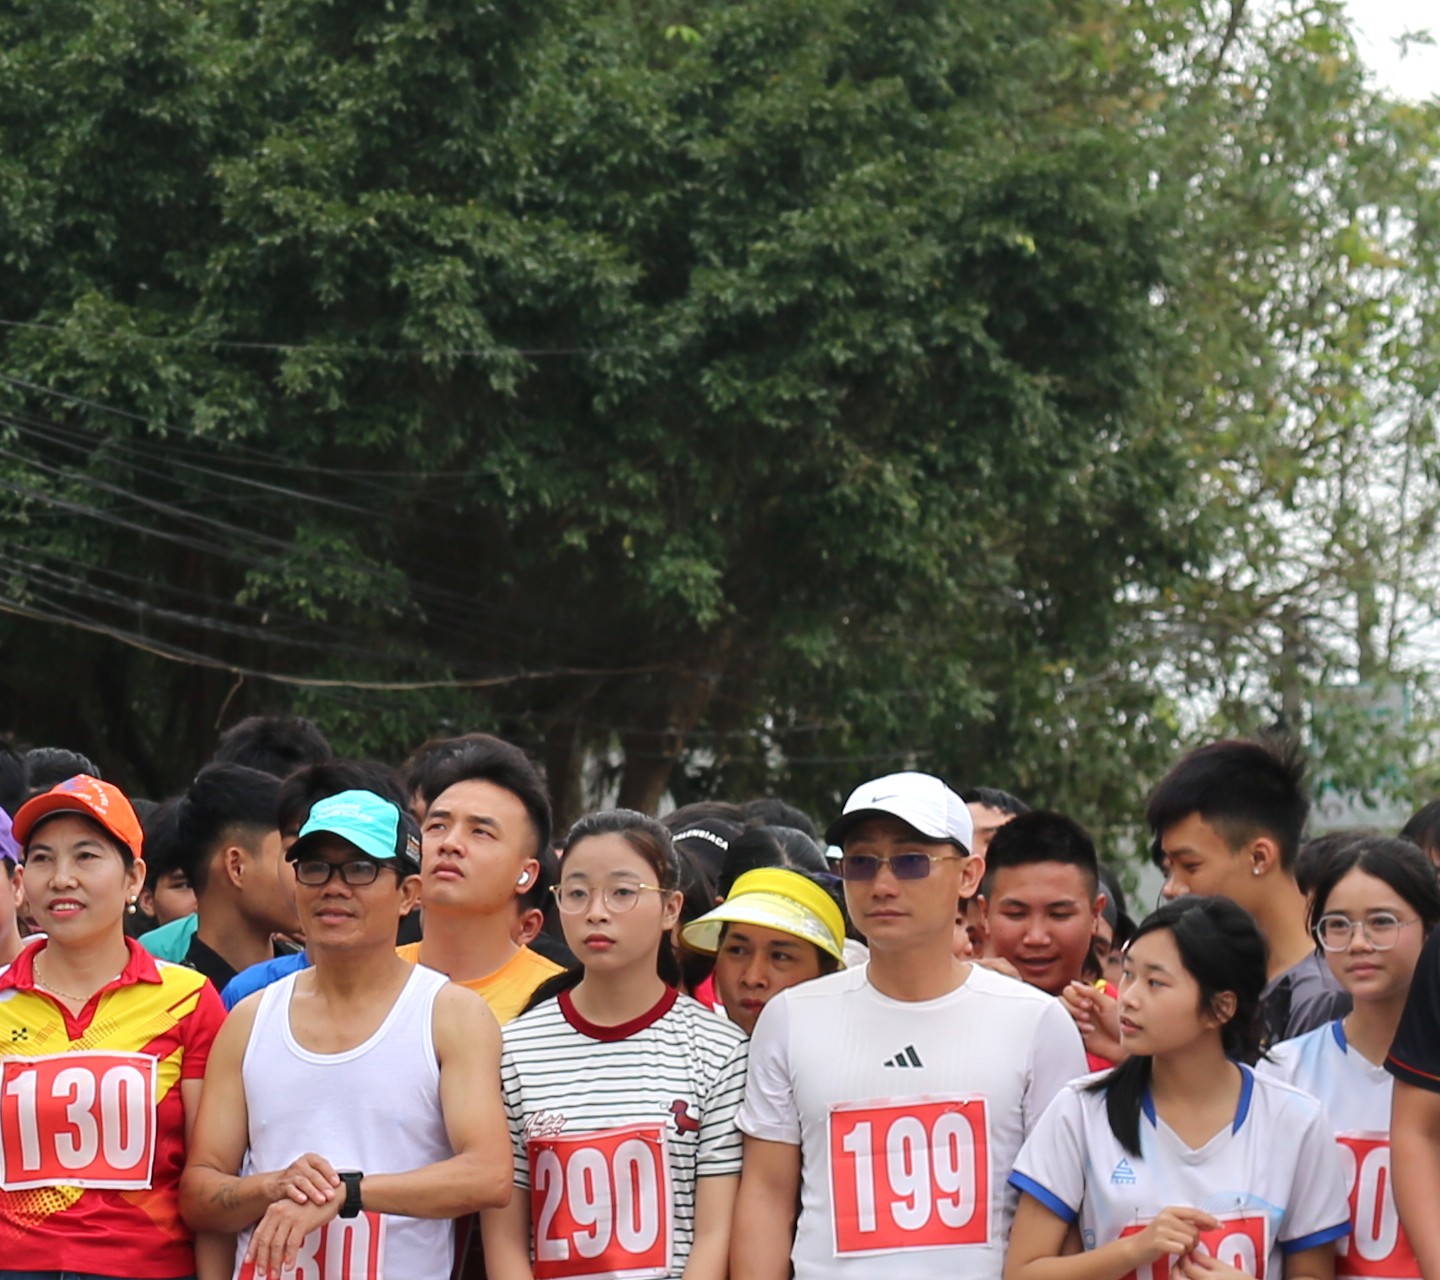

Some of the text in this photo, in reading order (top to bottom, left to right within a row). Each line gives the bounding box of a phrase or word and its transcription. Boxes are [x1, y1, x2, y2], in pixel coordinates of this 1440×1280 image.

[4, 1066, 146, 1170] 130
[842, 1112, 978, 1232] 199
[534, 1139, 660, 1262] 290
